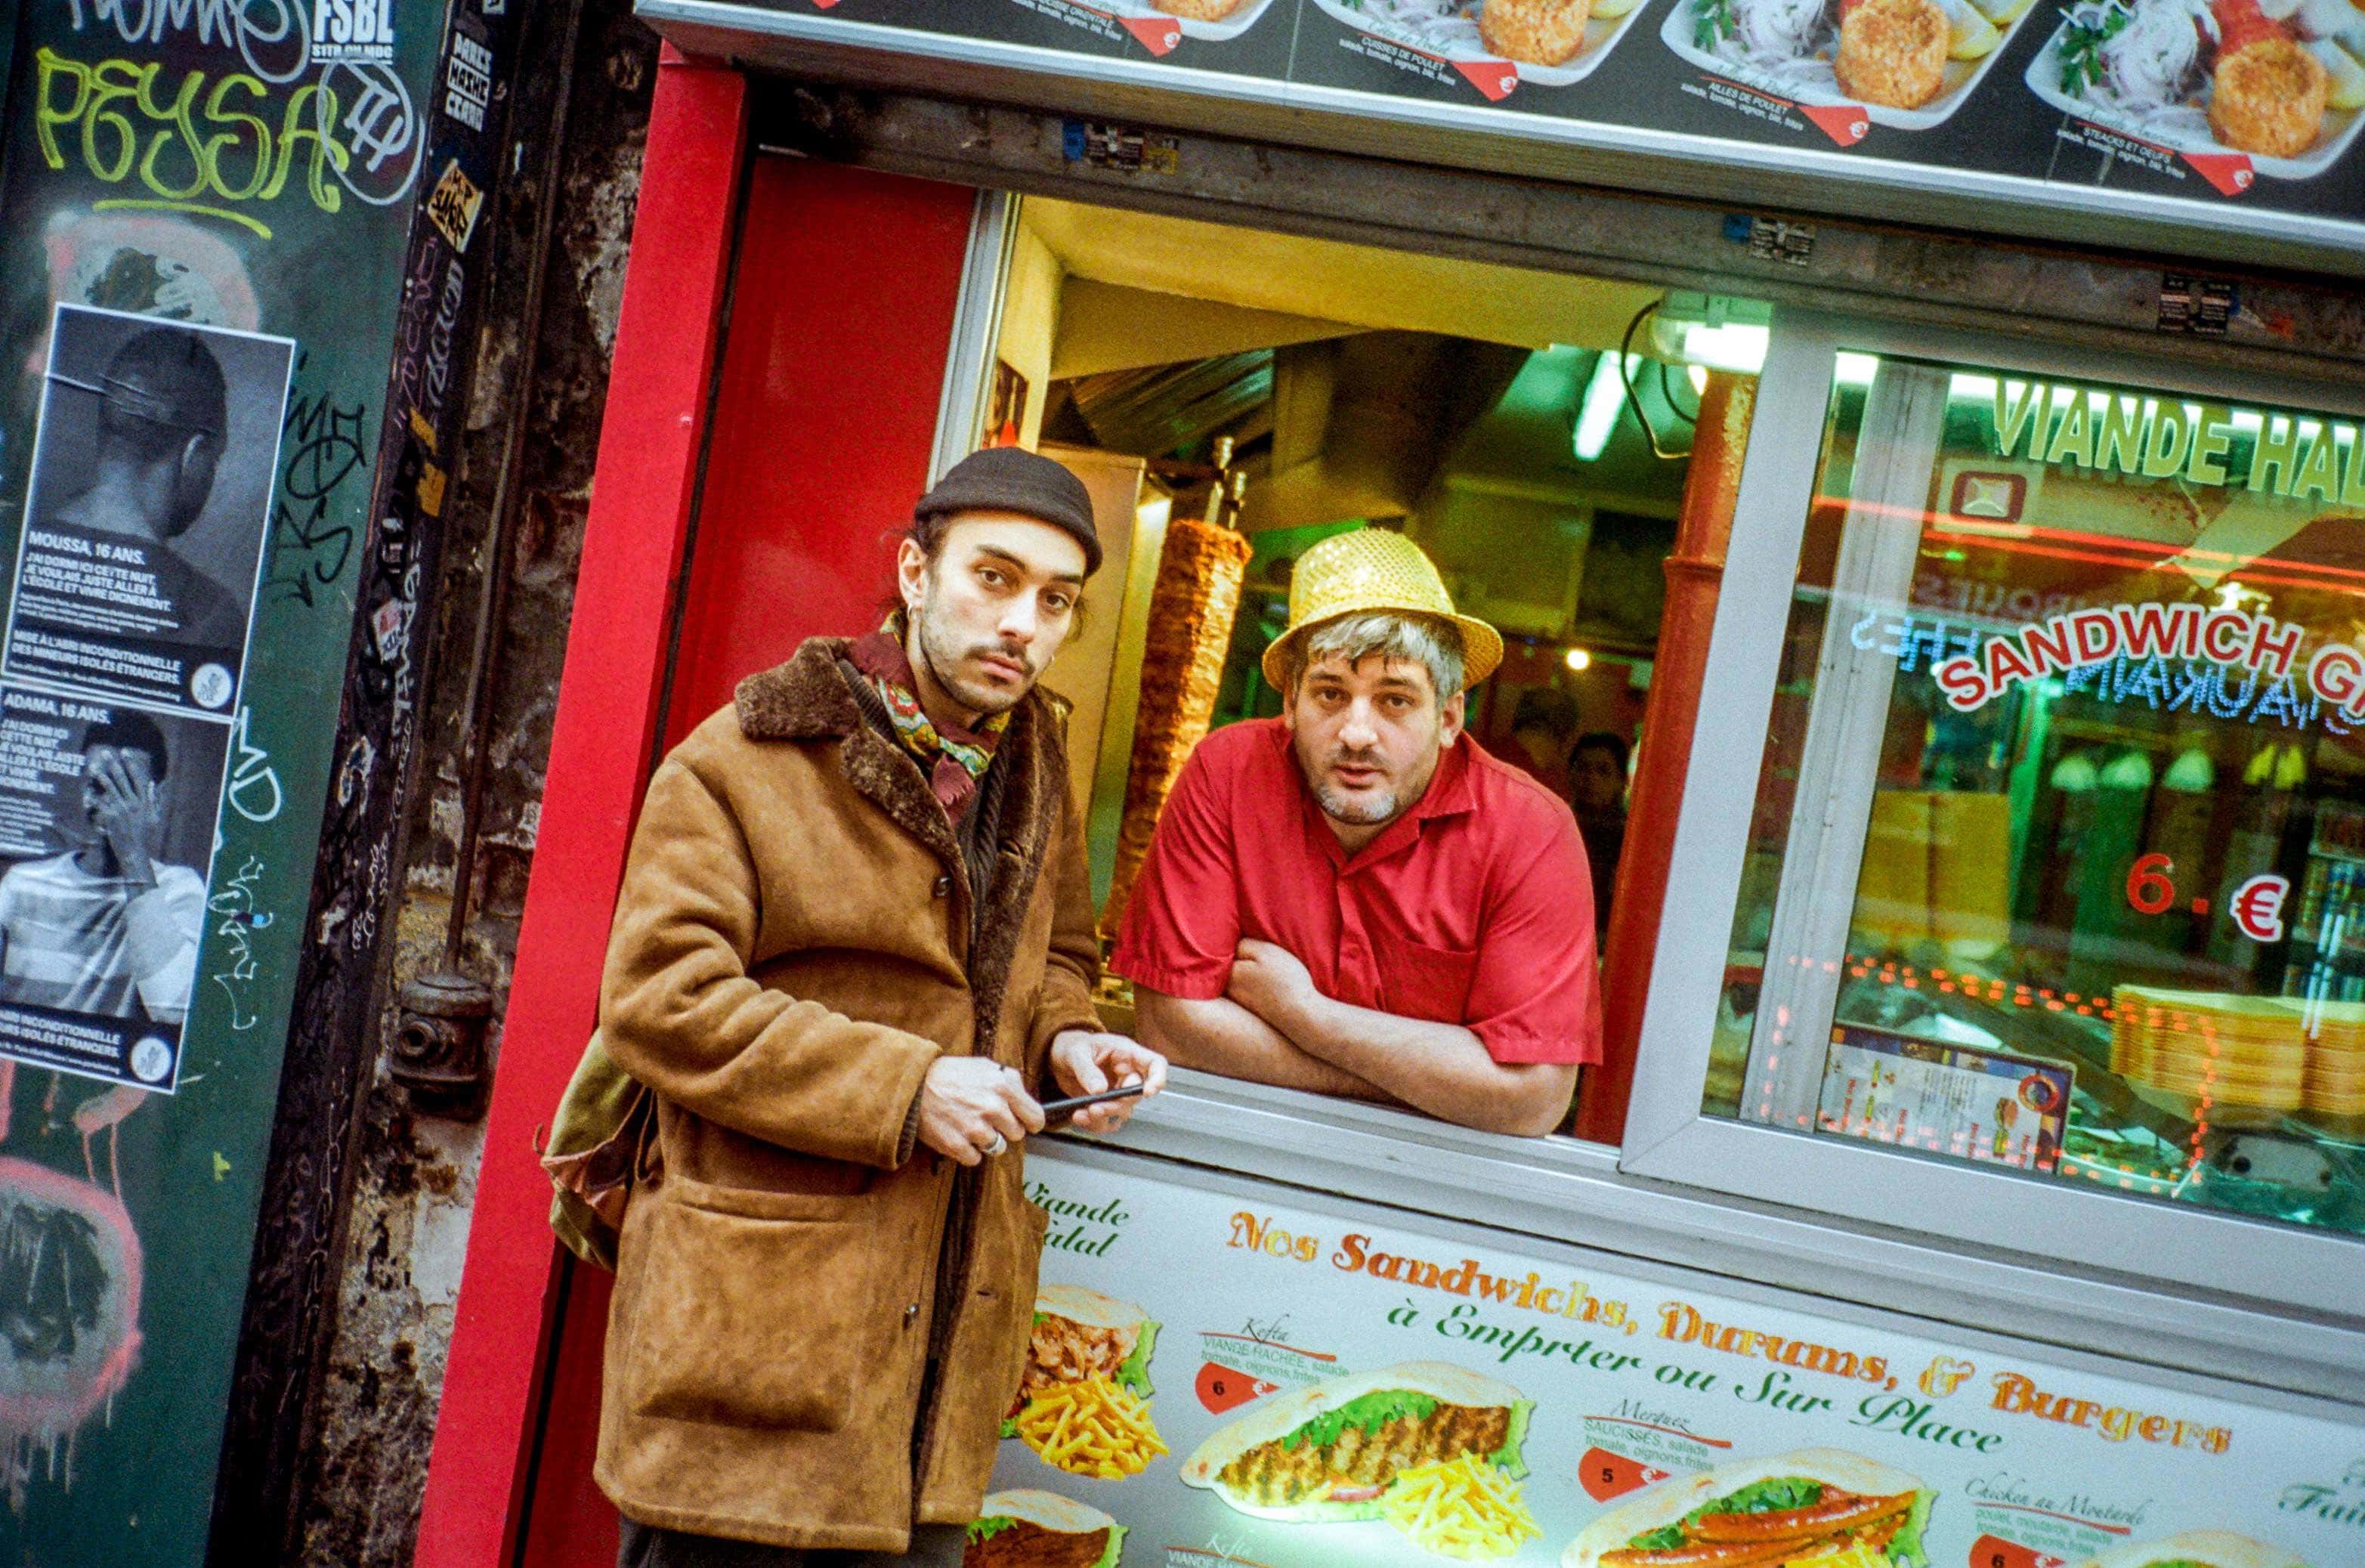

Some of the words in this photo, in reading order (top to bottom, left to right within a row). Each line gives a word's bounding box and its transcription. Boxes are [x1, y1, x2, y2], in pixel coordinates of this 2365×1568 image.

[1993, 376, 2234, 486] VIANDE
[29, 530, 92, 557] MOUSSA,
[94, 543, 111, 559] 16
[111, 546, 145, 565] ANS.
[1937, 604, 2304, 710] SANDWICH
[2309, 644, 2365, 716] G
[2229, 874, 2289, 942] €
[1043, 1219, 1120, 1258] alal
[1203, 1336, 1249, 1356] VIANDE
[1226, 1211, 1319, 1262] Nos
[1332, 1233, 1638, 1336] Sandwichs,
[1656, 1300, 1899, 1391] Durums,
[1917, 1354, 1975, 1399] &
[1989, 1371, 2233, 1454] Burgers
[1240, 1313, 1291, 1344] Kefta
[1212, 1380, 1226, 1396] 6
[1387, 1297, 1421, 1328] à
[1654, 1362, 1719, 1393] ou
[1735, 1370, 1835, 1415] Sur
[1848, 1393, 2003, 1455] Place
[1610, 1398, 1693, 1433] Merguez
[1601, 1467, 1615, 1483] 5
